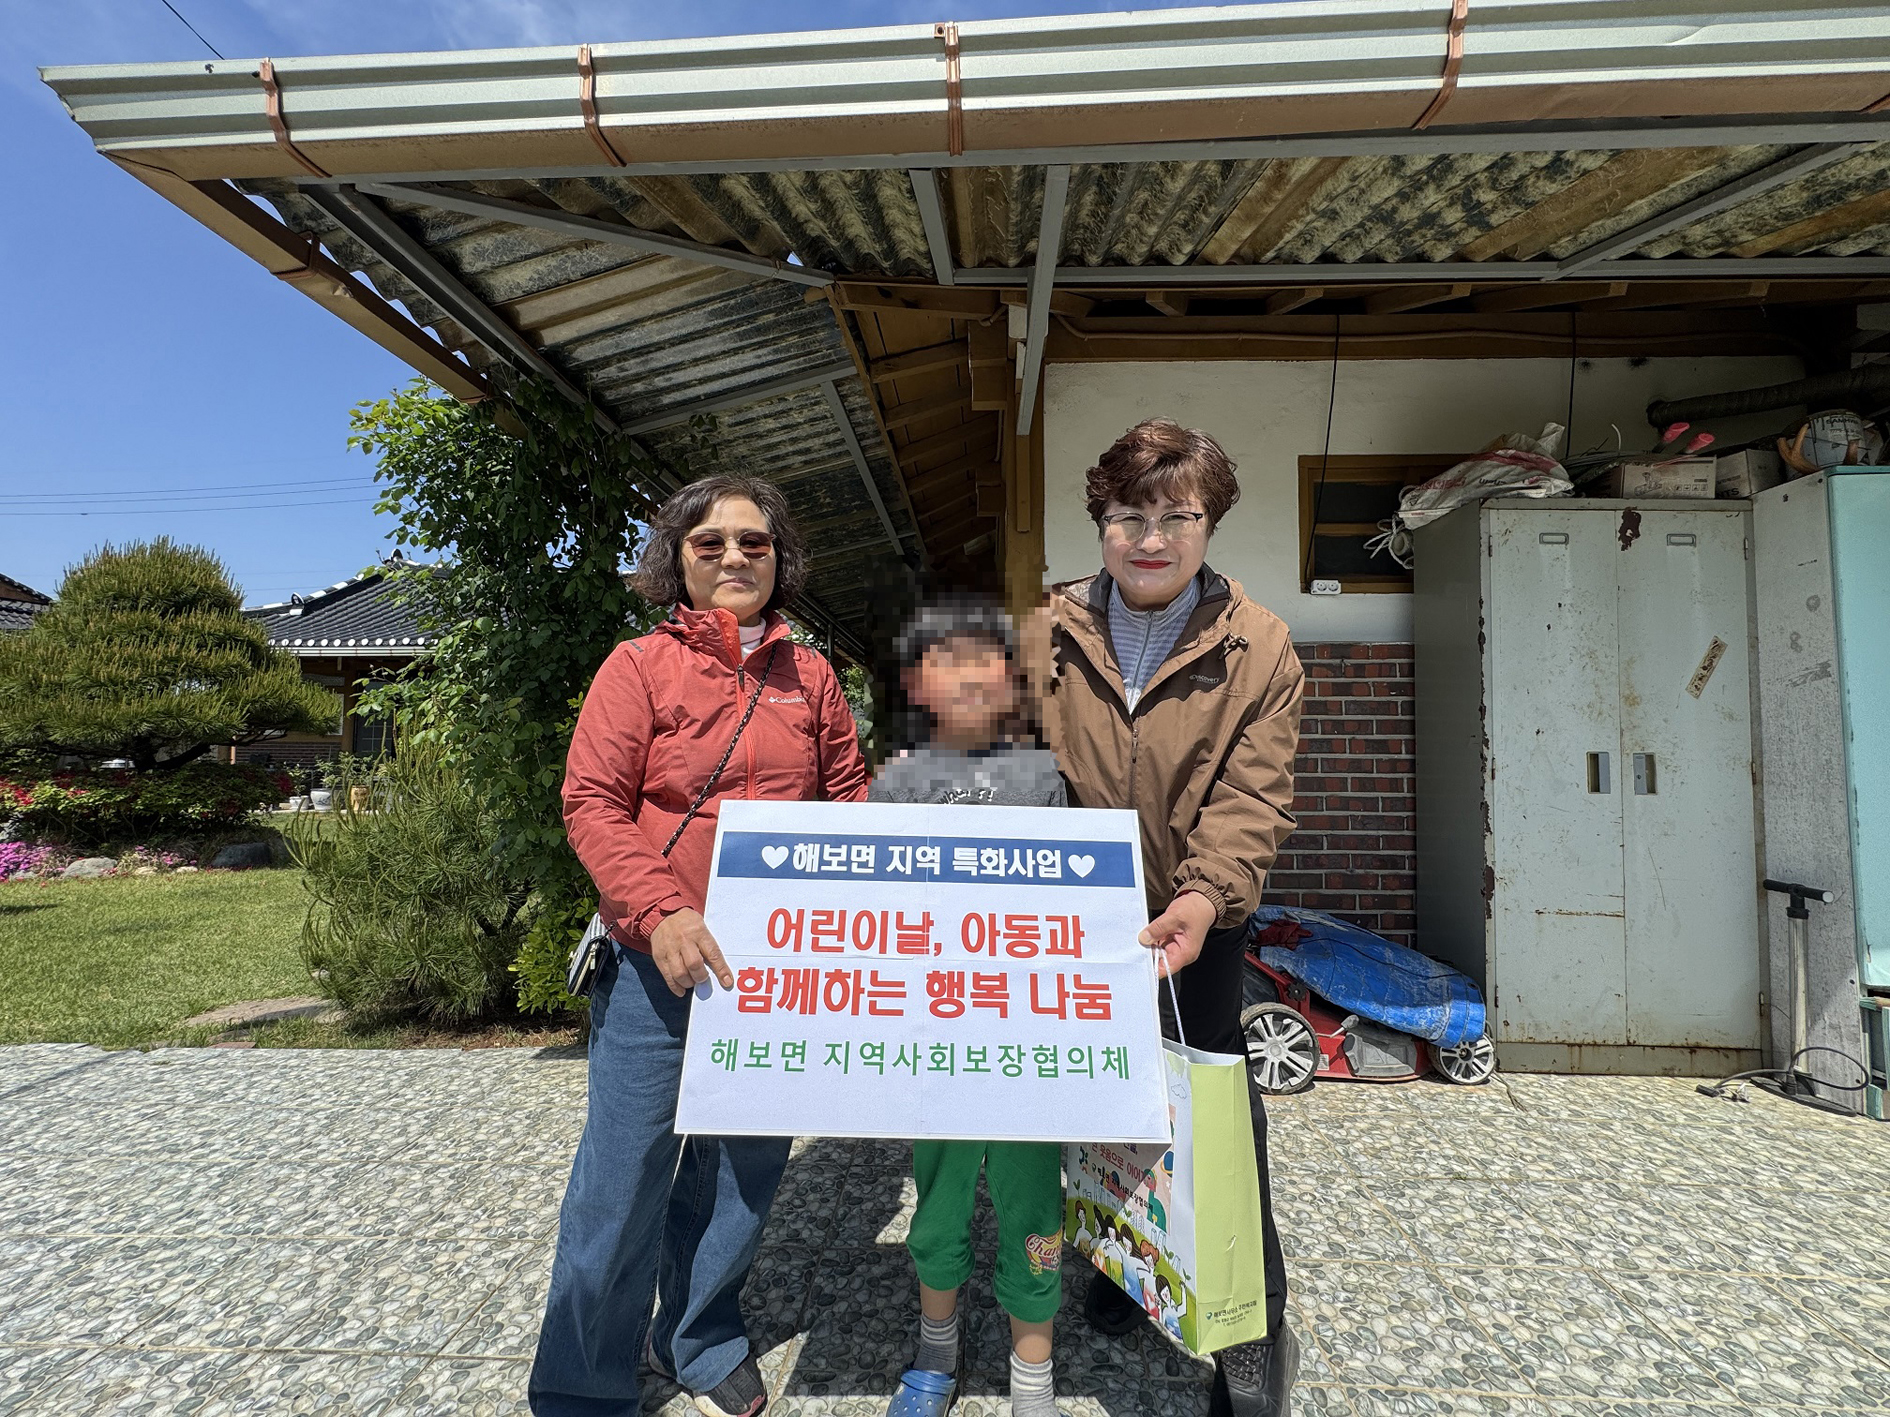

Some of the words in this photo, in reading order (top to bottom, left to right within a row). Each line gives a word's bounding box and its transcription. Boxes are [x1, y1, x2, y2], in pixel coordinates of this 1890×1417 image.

[792, 843, 875, 874] 해보면
[886, 845, 941, 875] 지역
[952, 847, 1062, 879] 특화사업
[767, 908, 942, 957] 어린이날,
[961, 912, 1085, 959] 아동과
[736, 966, 907, 1017] 함께하는
[925, 970, 1010, 1019] 행복
[1029, 972, 1112, 1021] 나눔
[710, 1038, 807, 1073] 해보면
[824, 1042, 1130, 1080] 지역사회보장협의체
[1100, 1144, 1124, 1171] 웃음으로
